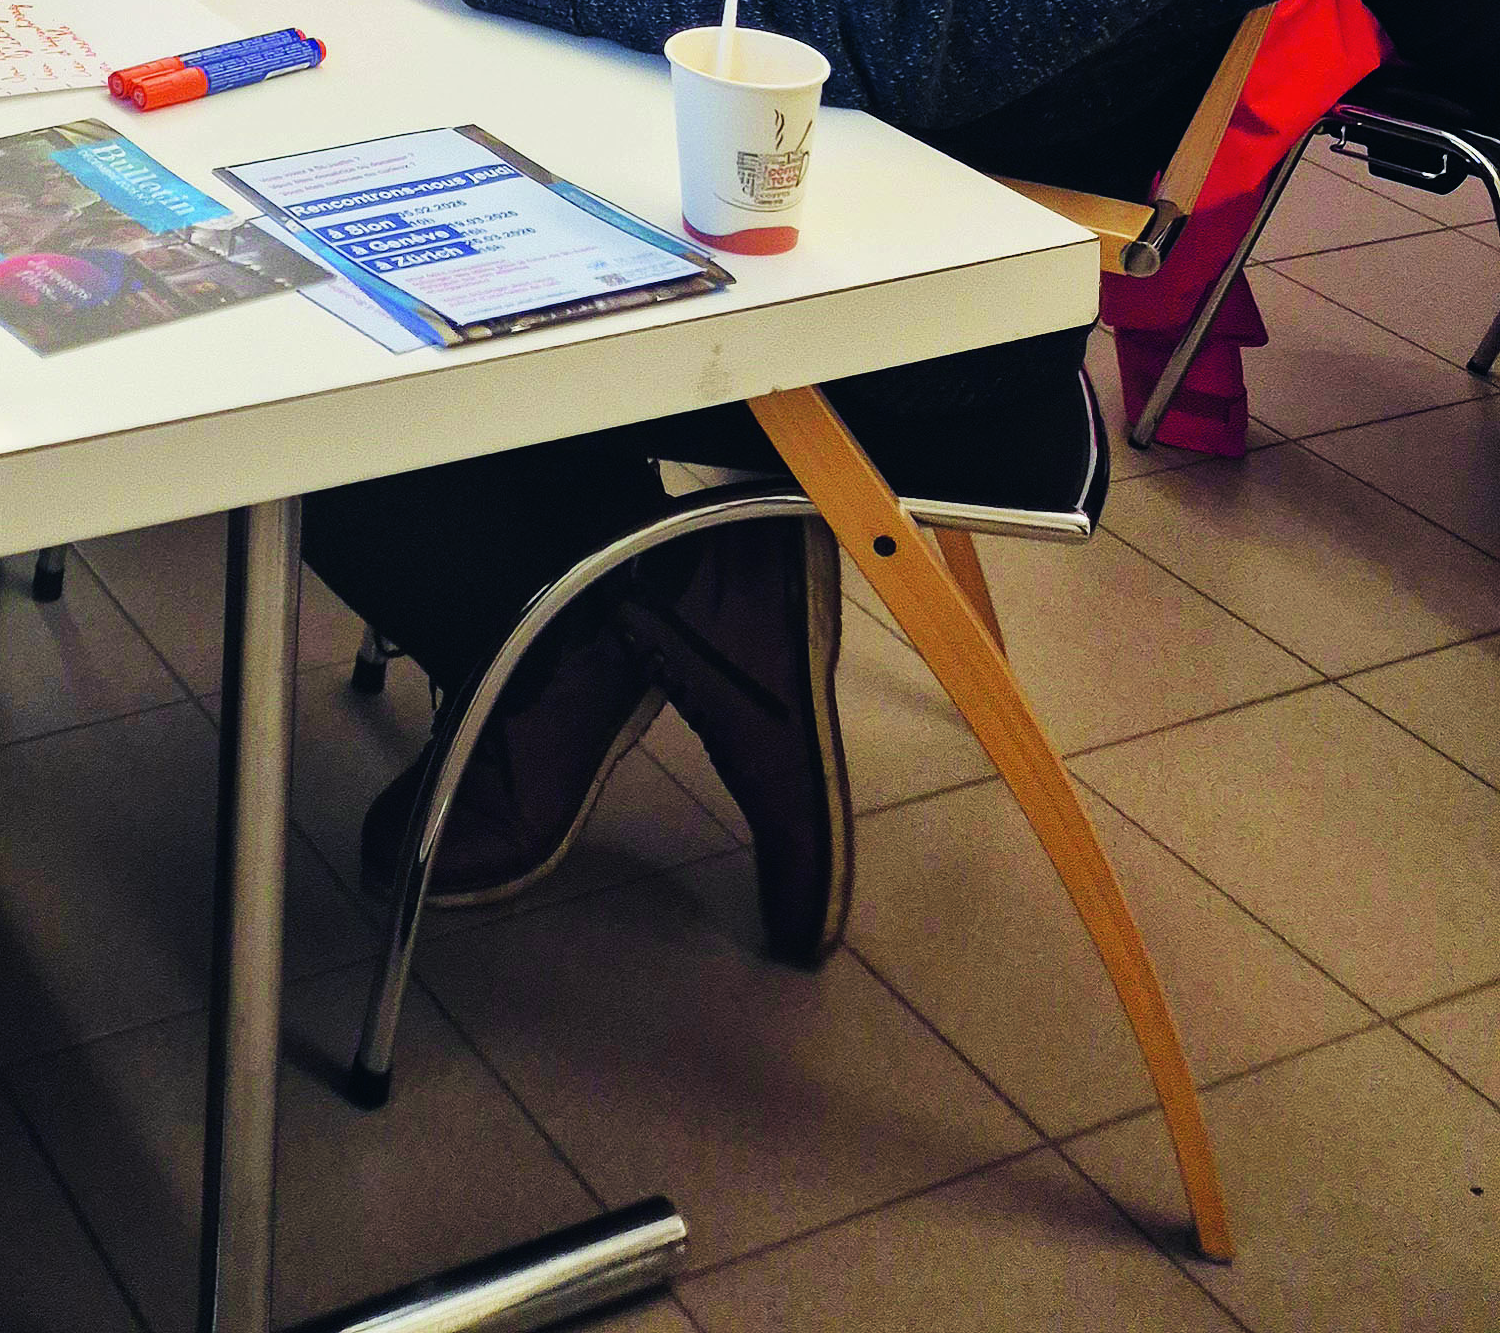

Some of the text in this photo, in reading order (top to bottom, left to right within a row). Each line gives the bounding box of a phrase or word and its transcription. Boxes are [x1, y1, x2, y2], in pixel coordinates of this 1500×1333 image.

[91, 144, 196, 217] Bulletin
[290, 175, 466, 218] Rencontrons-nous
[330, 226, 345, 240] à
[344, 219, 397, 236] Sion
[353, 242, 368, 256] à
[369, 229, 451, 253] Genève
[374, 258, 393, 271] à
[393, 245, 464, 269] Zürich
